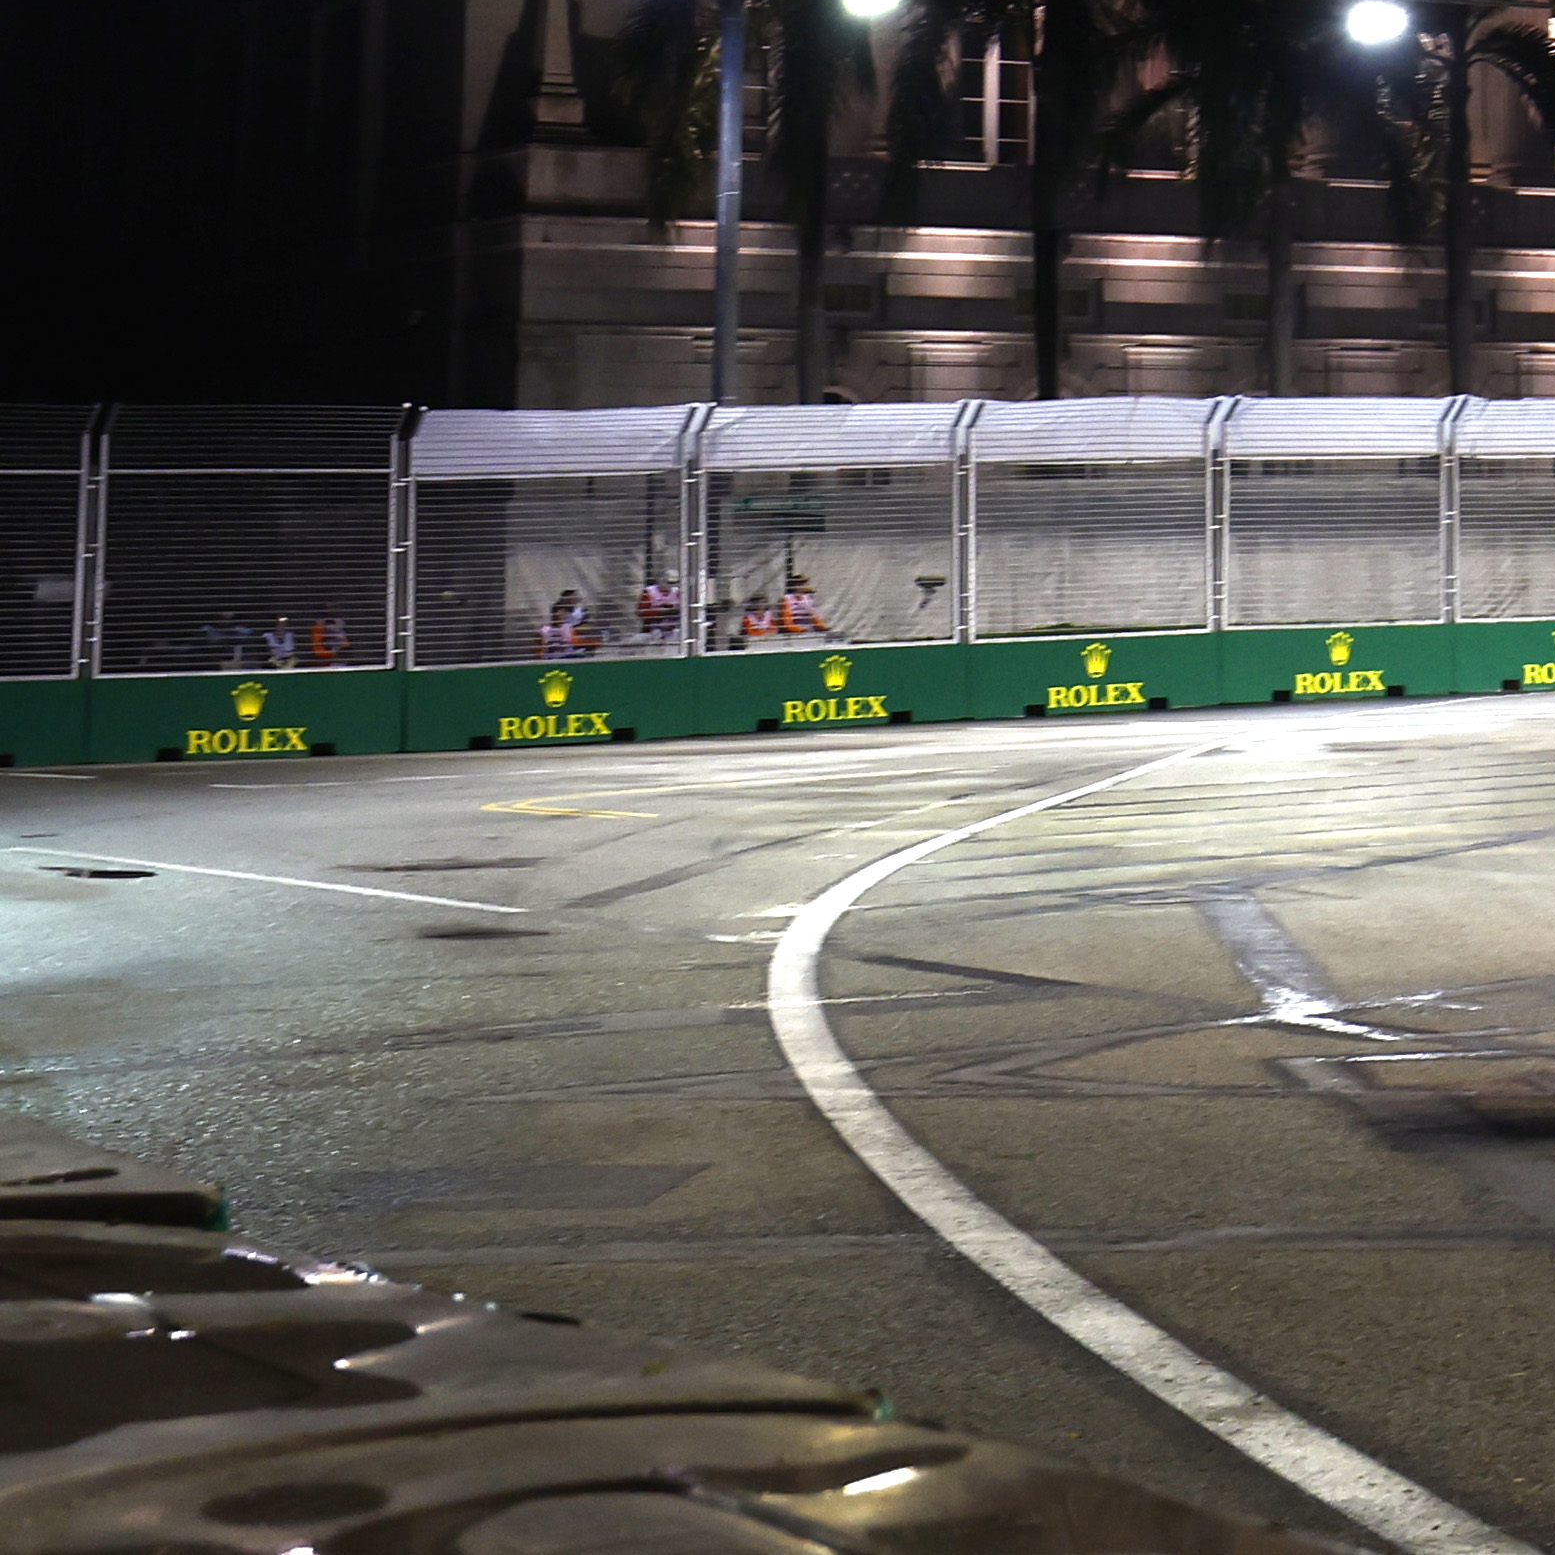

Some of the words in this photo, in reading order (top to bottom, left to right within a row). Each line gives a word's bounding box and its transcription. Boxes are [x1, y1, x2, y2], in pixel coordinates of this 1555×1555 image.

[1047, 682, 1146, 710] ROLEX
[1295, 669, 1387, 695] ROLEX
[782, 695, 888, 724] ROLEX
[499, 712, 611, 741] ROLEX
[186, 727, 308, 755] ROLEX
